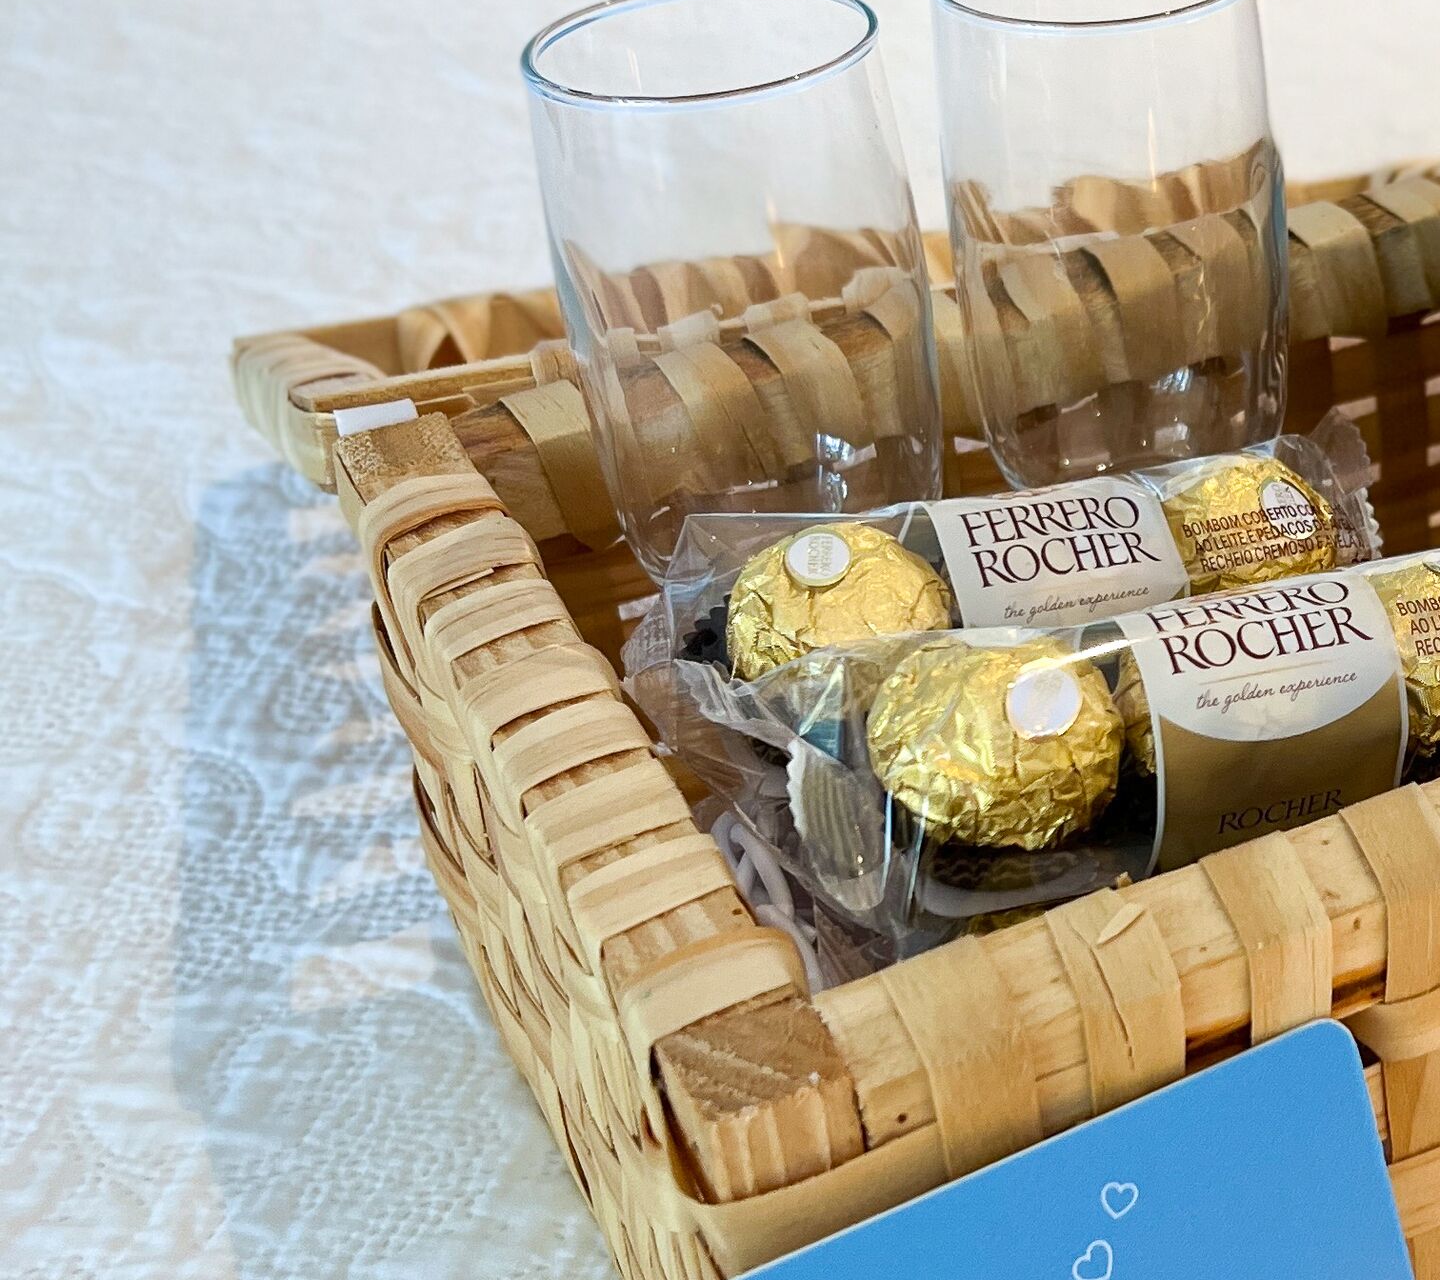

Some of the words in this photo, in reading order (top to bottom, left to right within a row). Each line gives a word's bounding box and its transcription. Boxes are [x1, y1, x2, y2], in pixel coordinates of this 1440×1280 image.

[958, 496, 1140, 548] FERRERO
[1182, 515, 1243, 539] BOMBOM
[1241, 504, 1298, 526] COBERTO
[1195, 539, 1213, 556] AO
[1213, 531, 1248, 552] LEITE
[1247, 529, 1257, 543] E
[971, 531, 1162, 589] ROCHER
[1201, 549, 1255, 573] RECHEIO
[1254, 538, 1315, 564] CREMOSO
[1003, 601, 1026, 620] the
[1029, 595, 1076, 623] golden
[1078, 585, 1151, 614] experience
[1146, 581, 1350, 634] FERRERO
[1159, 606, 1374, 676] ROCHER
[1410, 618, 1430, 636] AO
[1196, 689, 1219, 710] the
[1221, 682, 1276, 714] golden
[1279, 671, 1358, 702] experience
[1217, 789, 1344, 835] ROCHER
